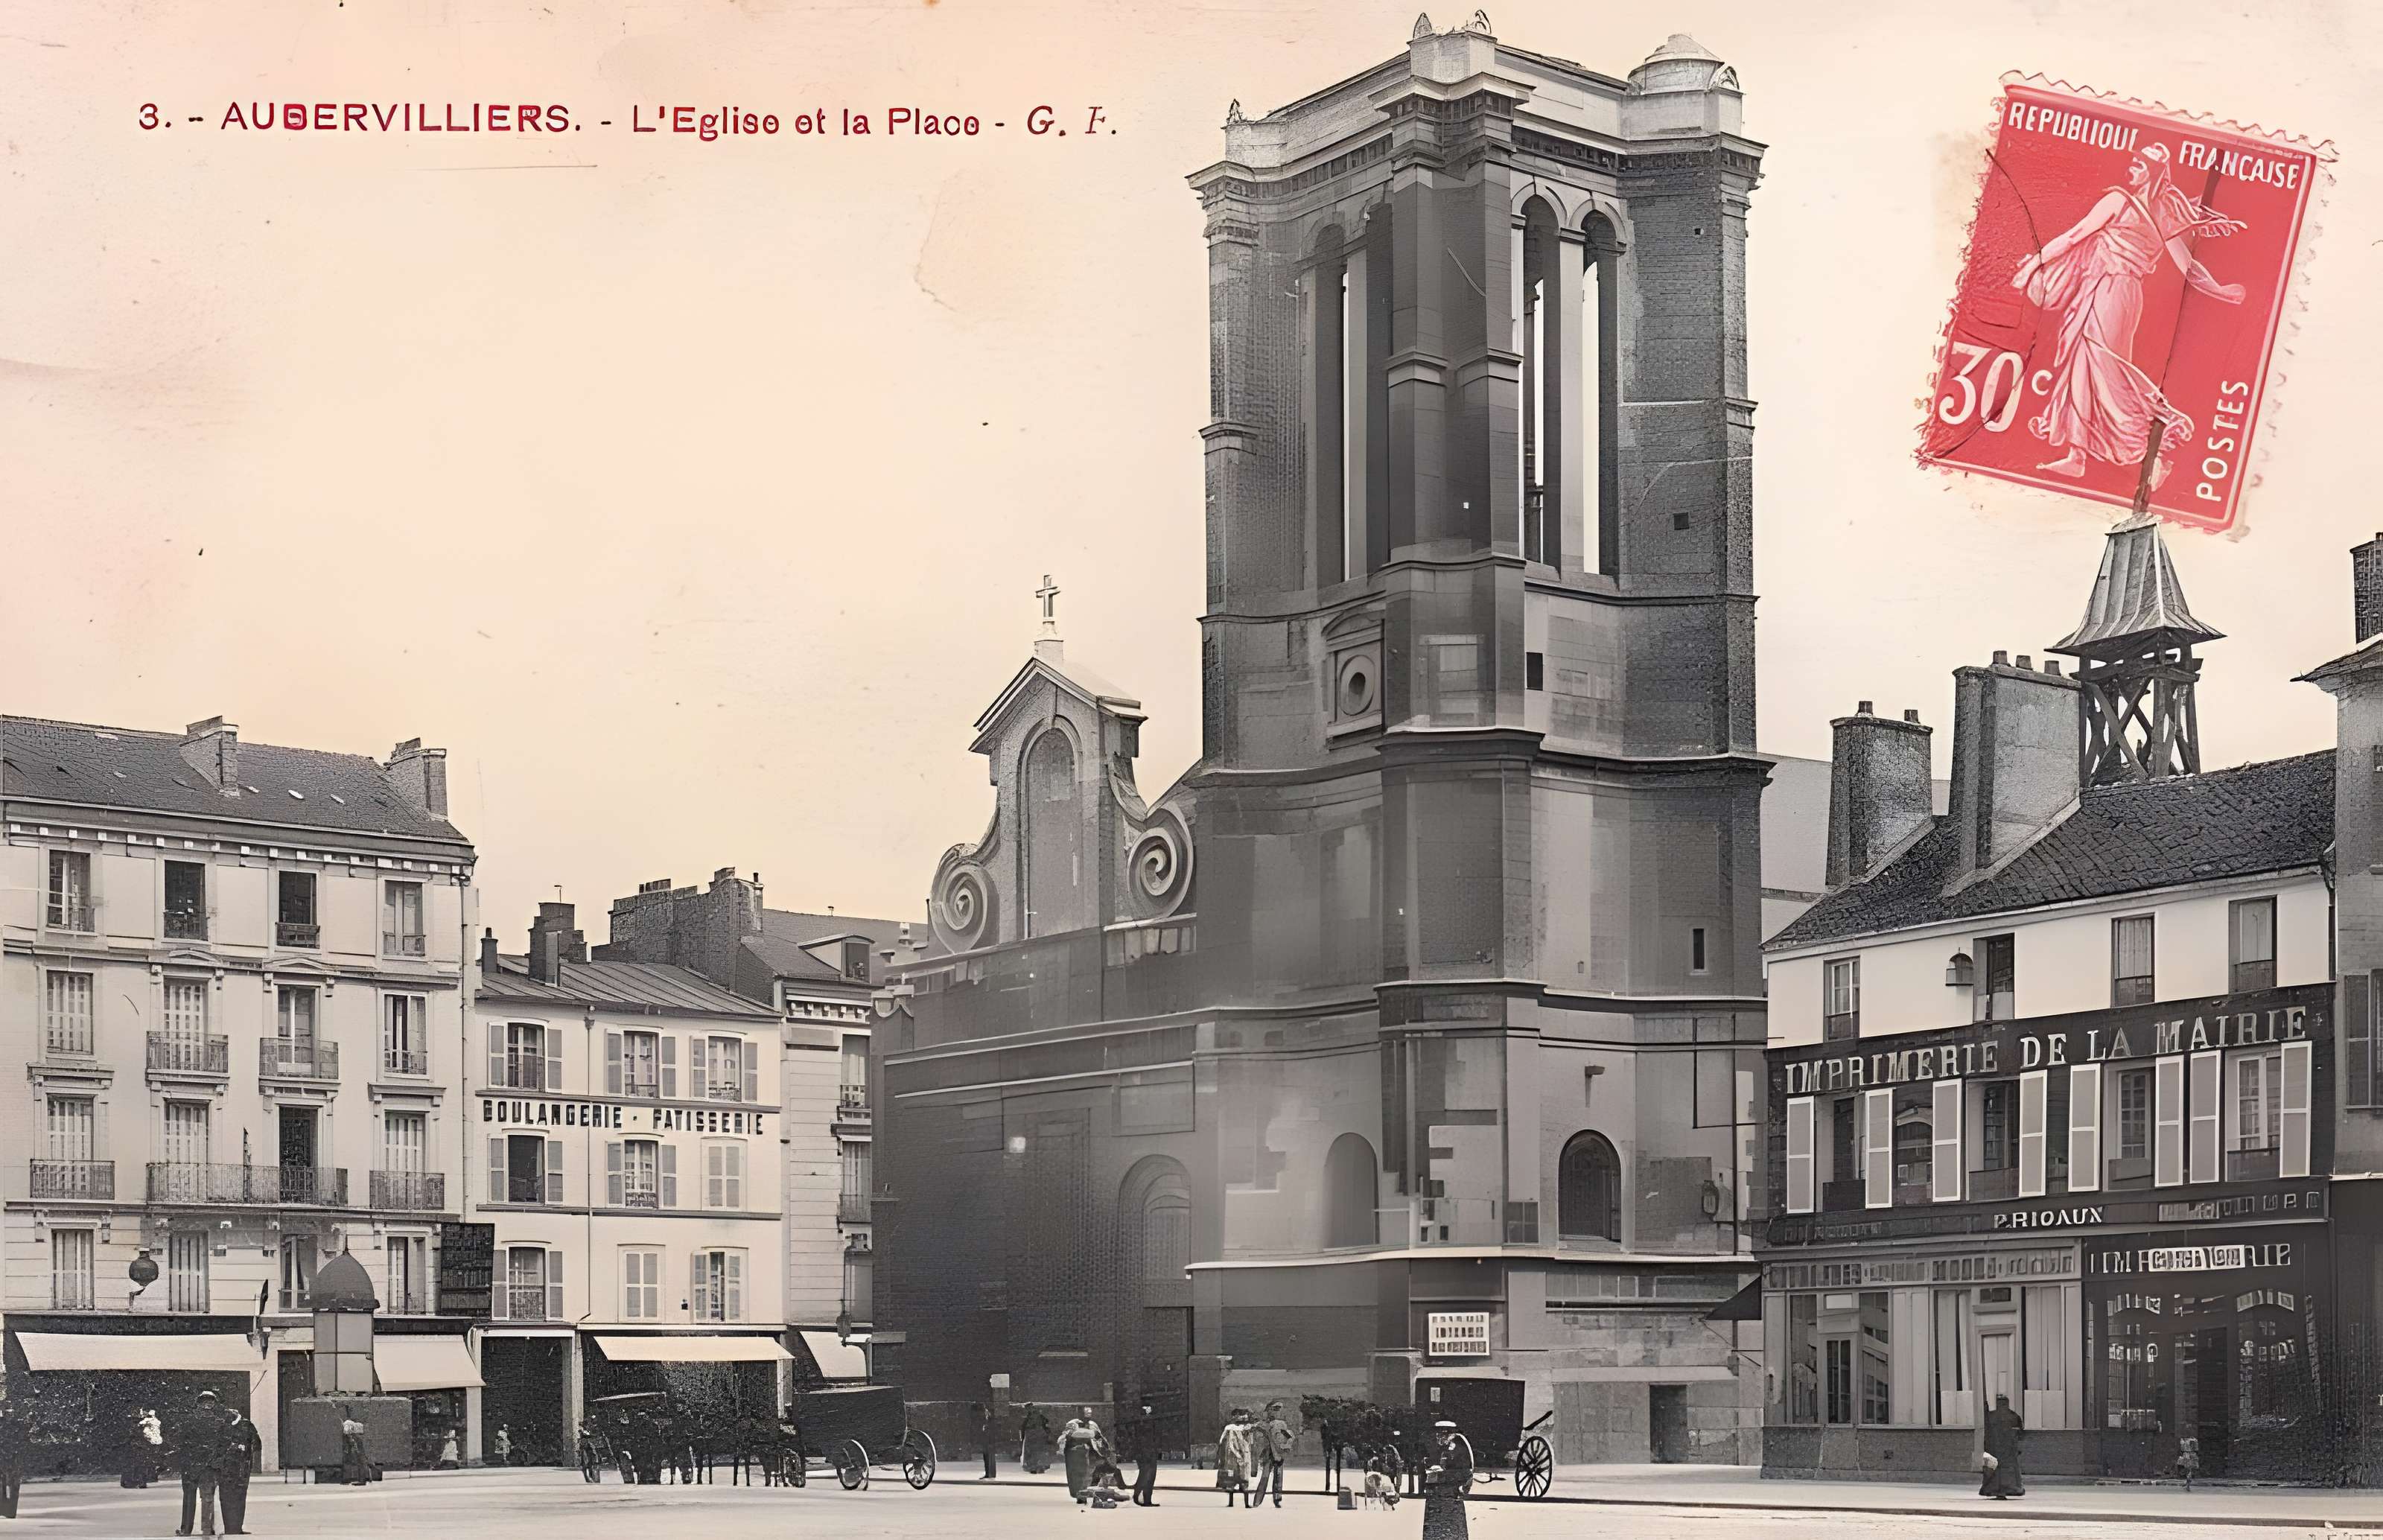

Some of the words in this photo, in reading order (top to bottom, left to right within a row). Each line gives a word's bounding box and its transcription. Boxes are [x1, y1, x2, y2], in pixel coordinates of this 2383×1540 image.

[1939, 341, 2024, 433] 30
[2196, 381, 2248, 502] POSTES
[1785, 1040, 1999, 1094] IMPRIMERIE
[2020, 1033, 2067, 1069] DE
[2086, 1027, 2135, 1062] LA
[2151, 1005, 2306, 1056] MAIRIE
